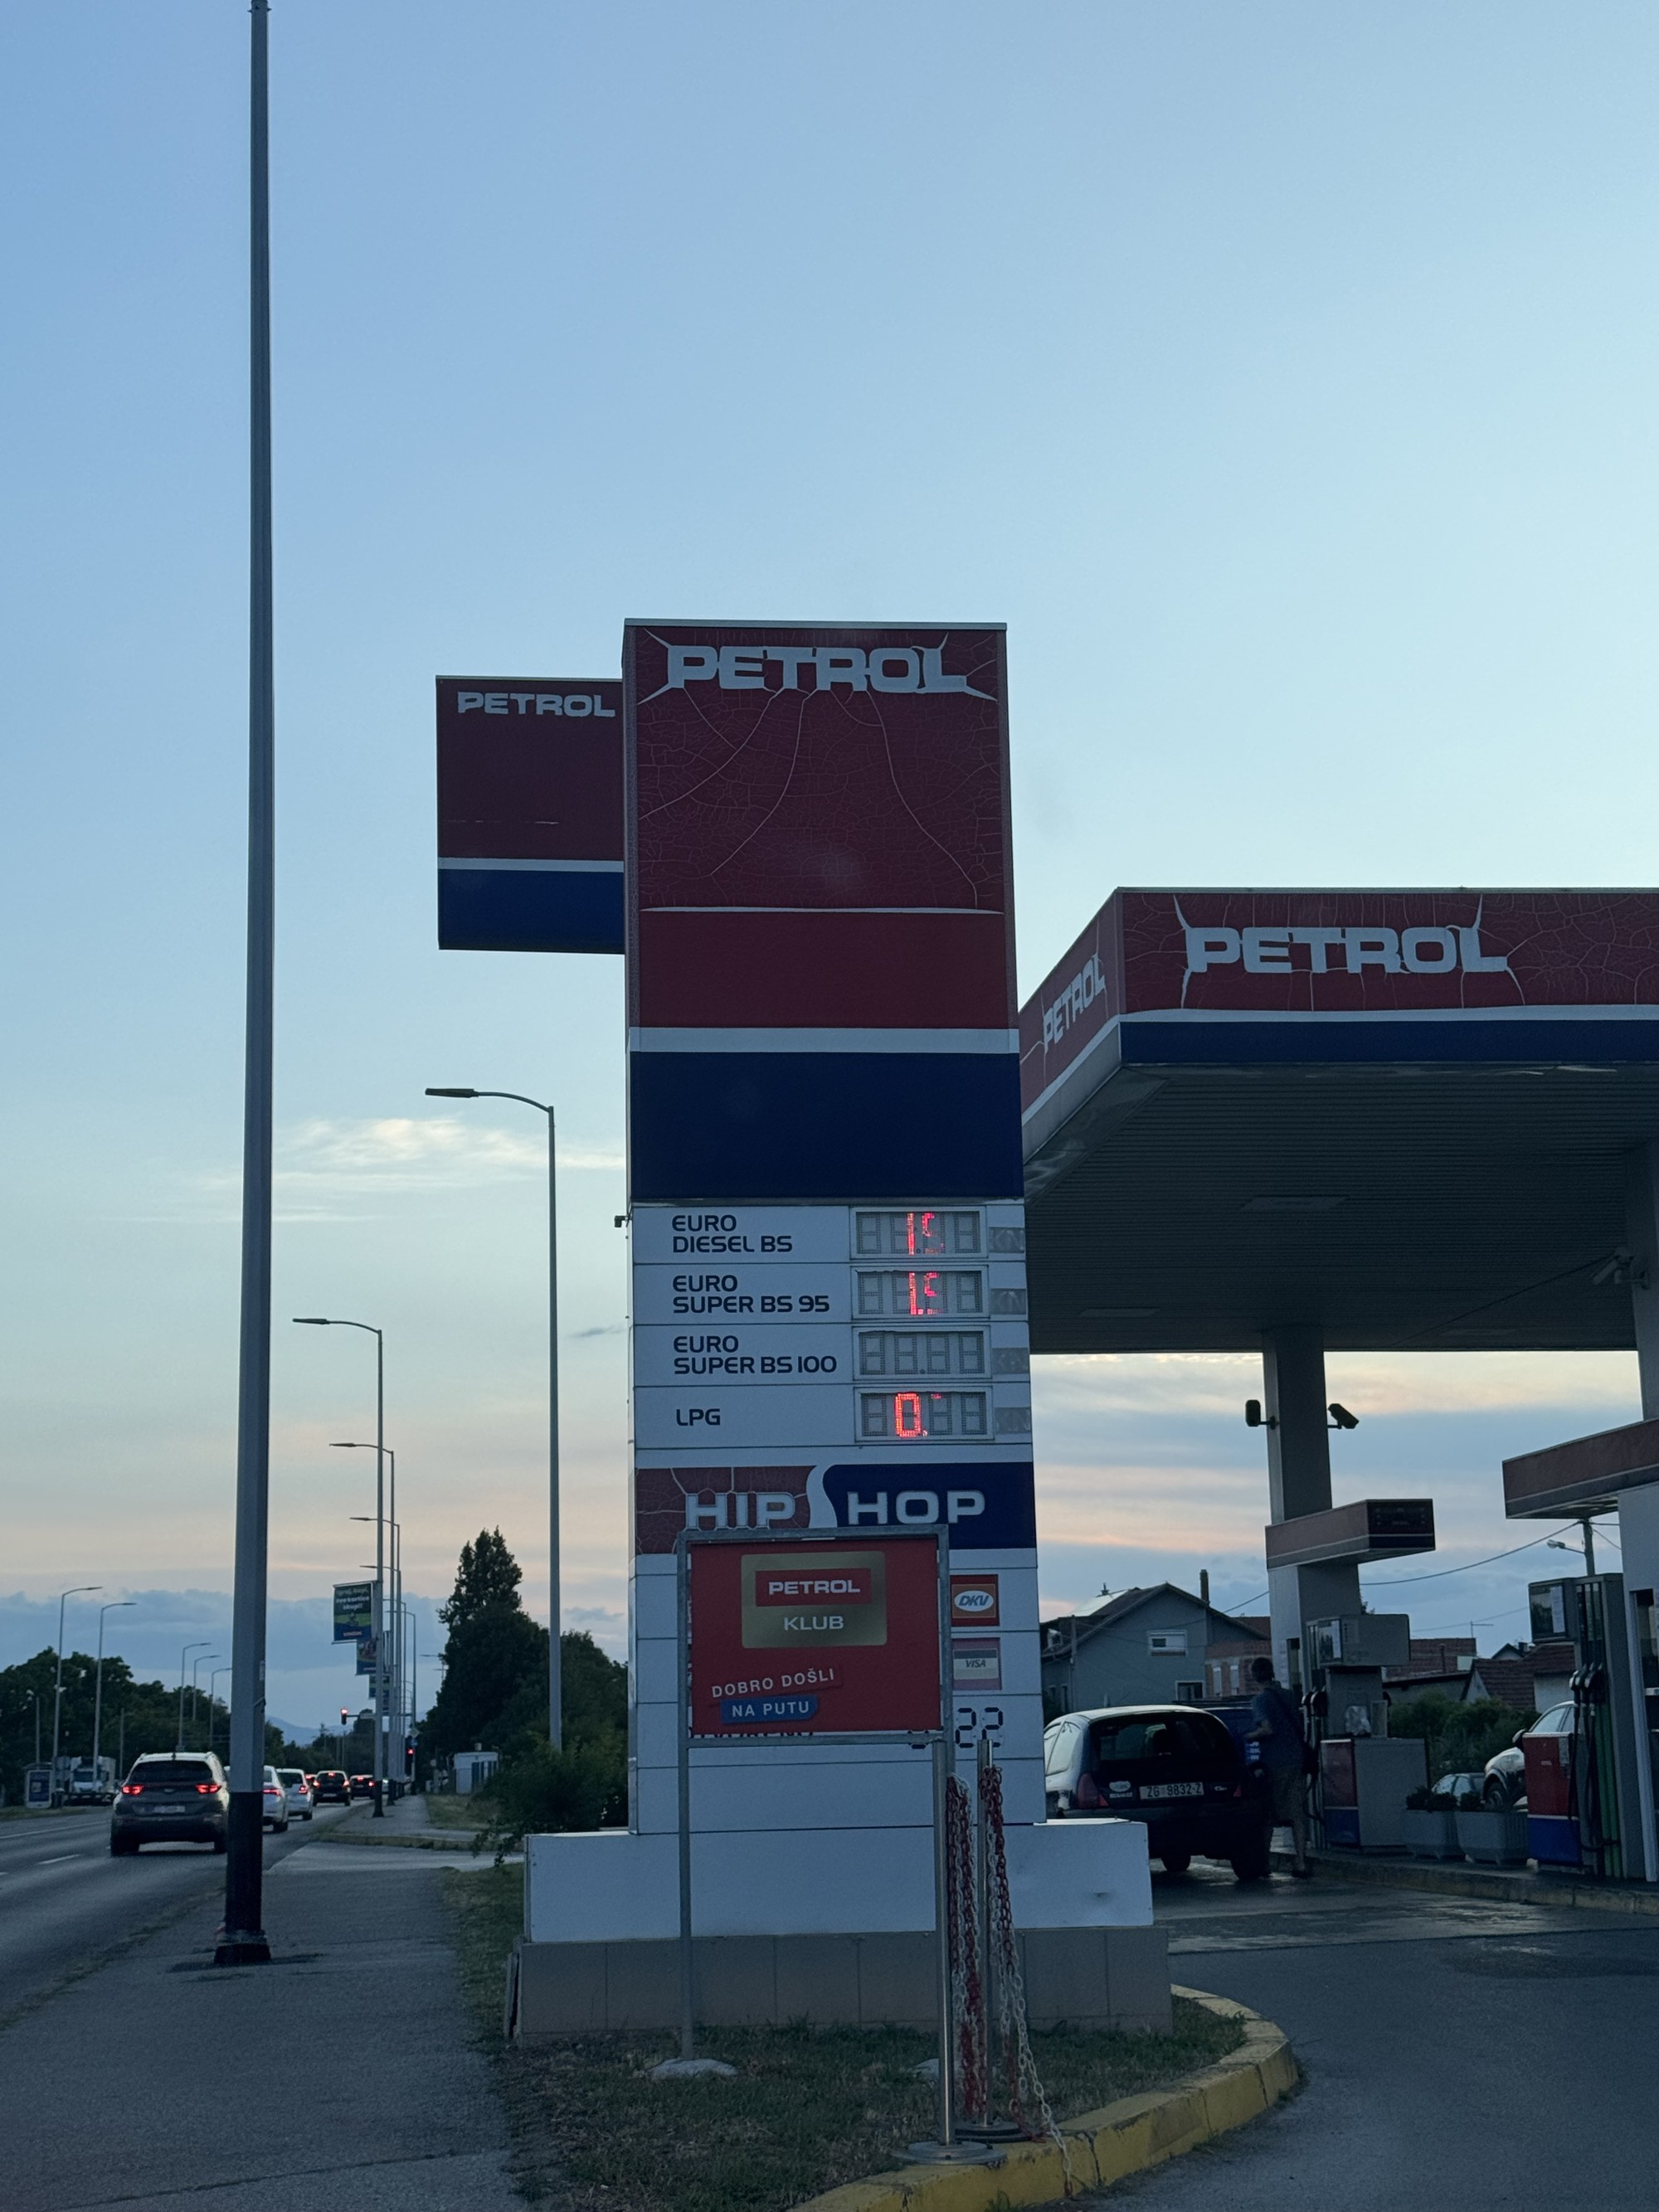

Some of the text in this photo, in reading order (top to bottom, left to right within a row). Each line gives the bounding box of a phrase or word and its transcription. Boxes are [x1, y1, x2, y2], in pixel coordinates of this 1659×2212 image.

[663, 643, 970, 693] PETROL
[458, 691, 615, 717] PETROL
[1182, 922, 1511, 977] PETROL
[1044, 953, 1107, 1053] PETROL
[672, 1214, 737, 1232] EURO
[673, 1235, 793, 1253] DIESEL BS
[673, 1274, 737, 1293] EURO
[673, 1295, 830, 1314] SUPER BS 95
[674, 1334, 739, 1354] EURO
[674, 1355, 837, 1375] SUPER BS 100
[676, 1408, 721, 1427] LPG
[685, 1493, 795, 1528] HIP
[768, 1579, 861, 1596] PETROL
[958, 1595, 990, 1607] DKV
[783, 1615, 844, 1631] KLUB
[965, 1659, 986, 1668] VISA
[711, 1667, 834, 1698] DOBRO DOŠLI
[732, 1700, 810, 1718] NA PUTU
[1146, 1786, 1160, 1797] ZG
